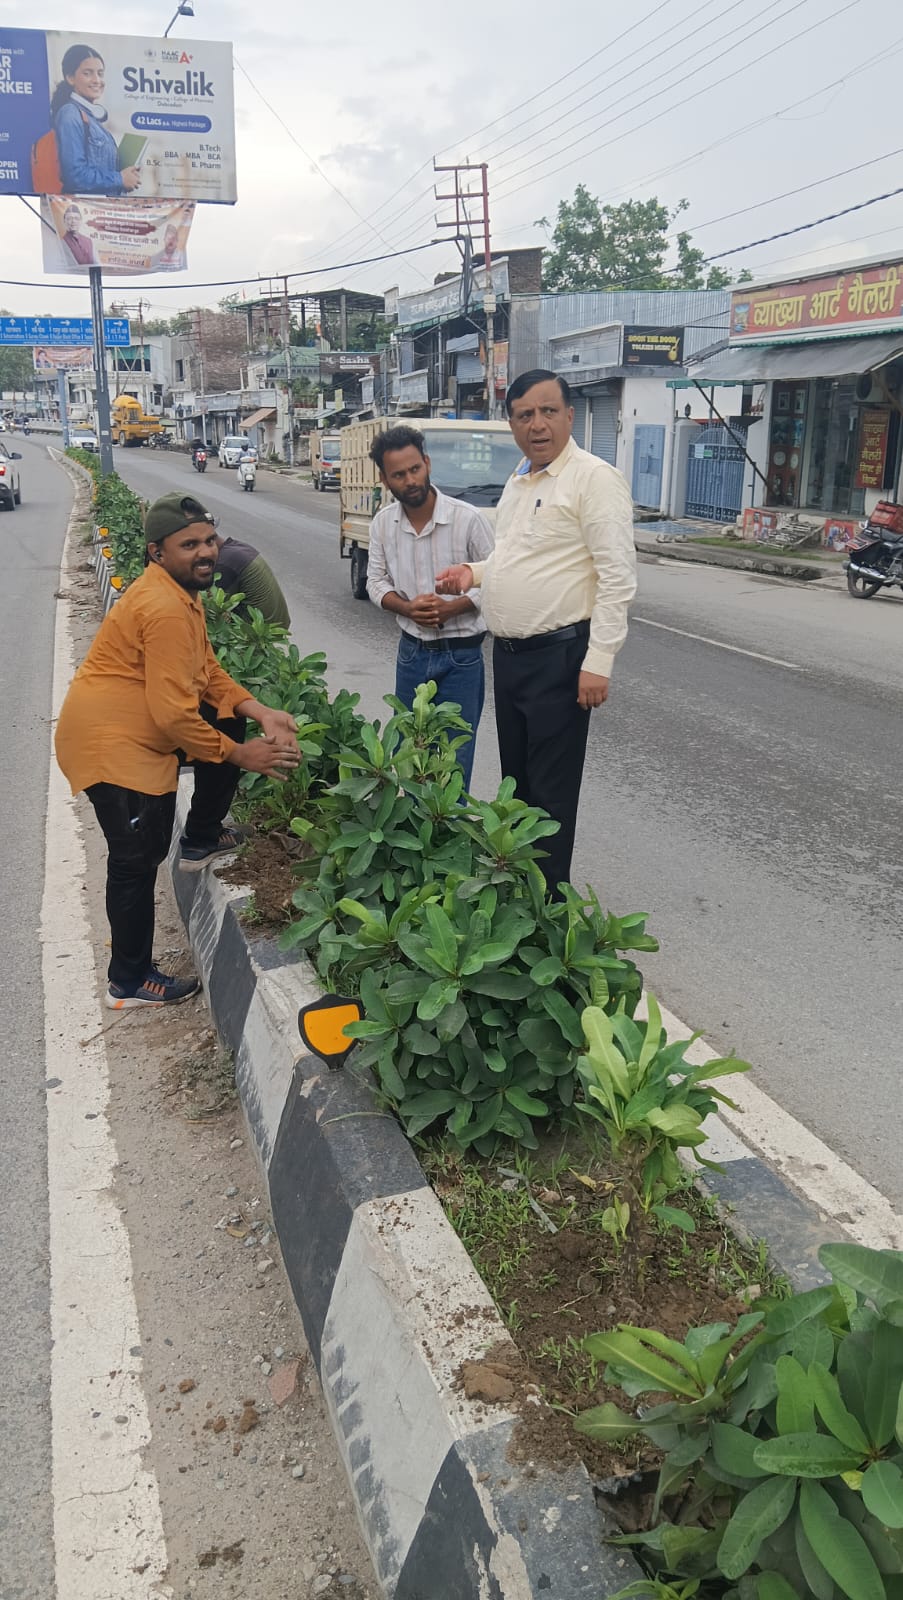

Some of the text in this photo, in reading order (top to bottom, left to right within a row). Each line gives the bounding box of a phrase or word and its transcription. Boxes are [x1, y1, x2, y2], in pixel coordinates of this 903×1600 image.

[123, 66, 215, 97] Shivalik
[135, 116, 146, 124] 42
[146, 116, 161, 126] Lacs
[199, 144, 221, 152] B.Tech
[753, 266, 901, 327] व्याख्या आर्ट गैलरी
[865, 434, 880, 446] आर्ट
[861, 446, 881, 460] गैलरी
